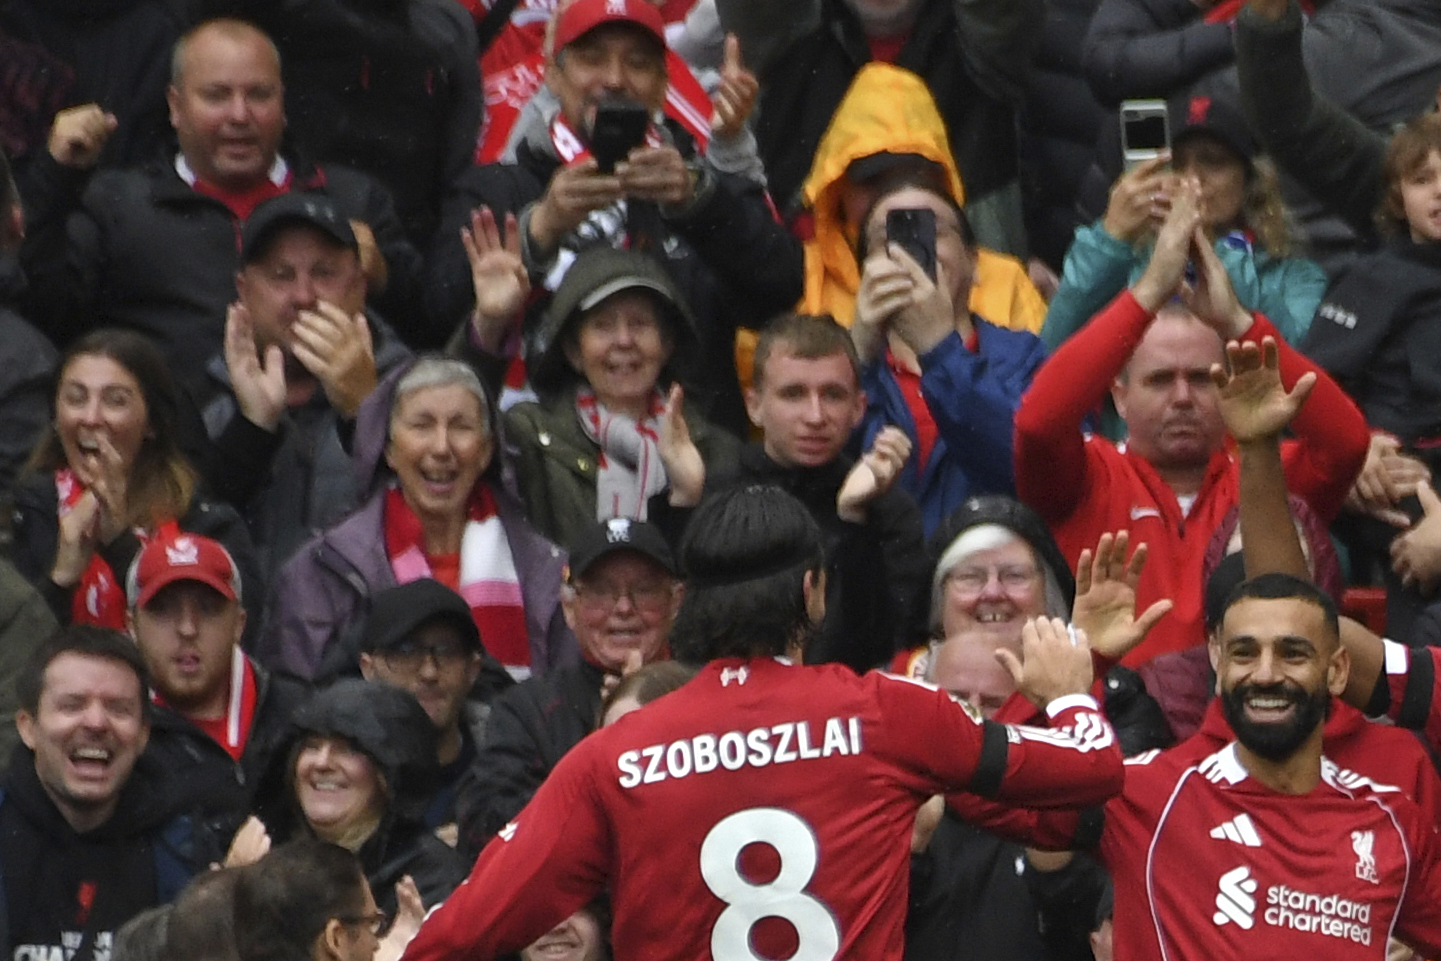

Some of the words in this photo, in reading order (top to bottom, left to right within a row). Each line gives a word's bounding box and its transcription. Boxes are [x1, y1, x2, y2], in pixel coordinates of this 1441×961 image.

[617, 716, 862, 789] SZOBOSZLAI
[1266, 885, 1371, 924] standard
[1264, 906, 1372, 947] chartered
